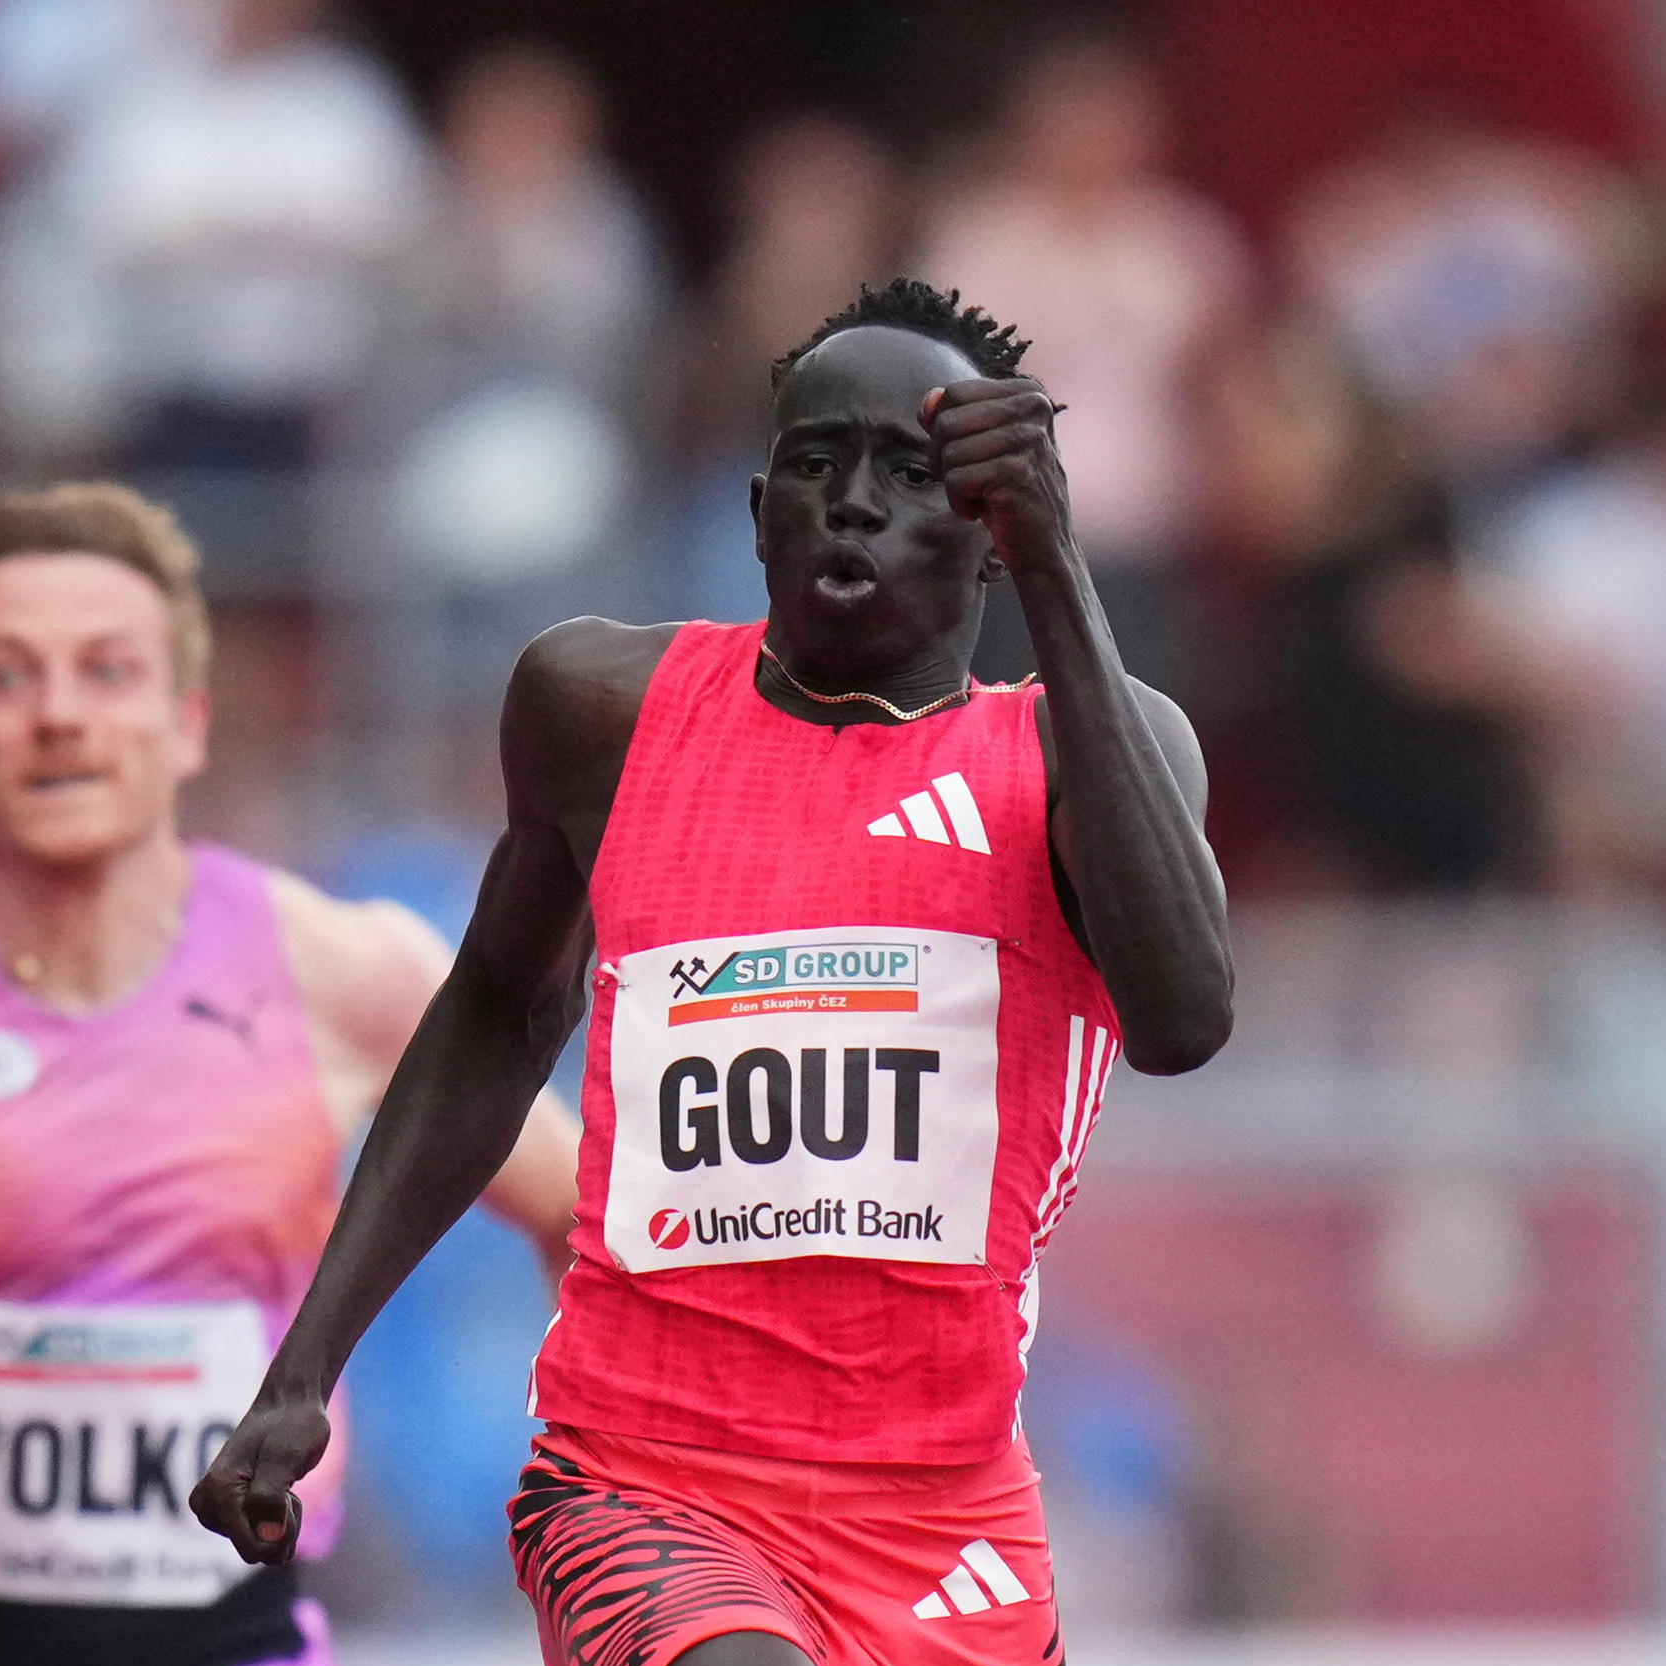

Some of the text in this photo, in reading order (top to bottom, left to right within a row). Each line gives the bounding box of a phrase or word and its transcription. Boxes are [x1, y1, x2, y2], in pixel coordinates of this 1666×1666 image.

[734, 951, 909, 984] SD GROUP
[730, 994, 847, 1013] člen Skupiny ČEZ
[658, 1047, 940, 1173] GOUT
[694, 1198, 944, 1245] UniCredit Bank
